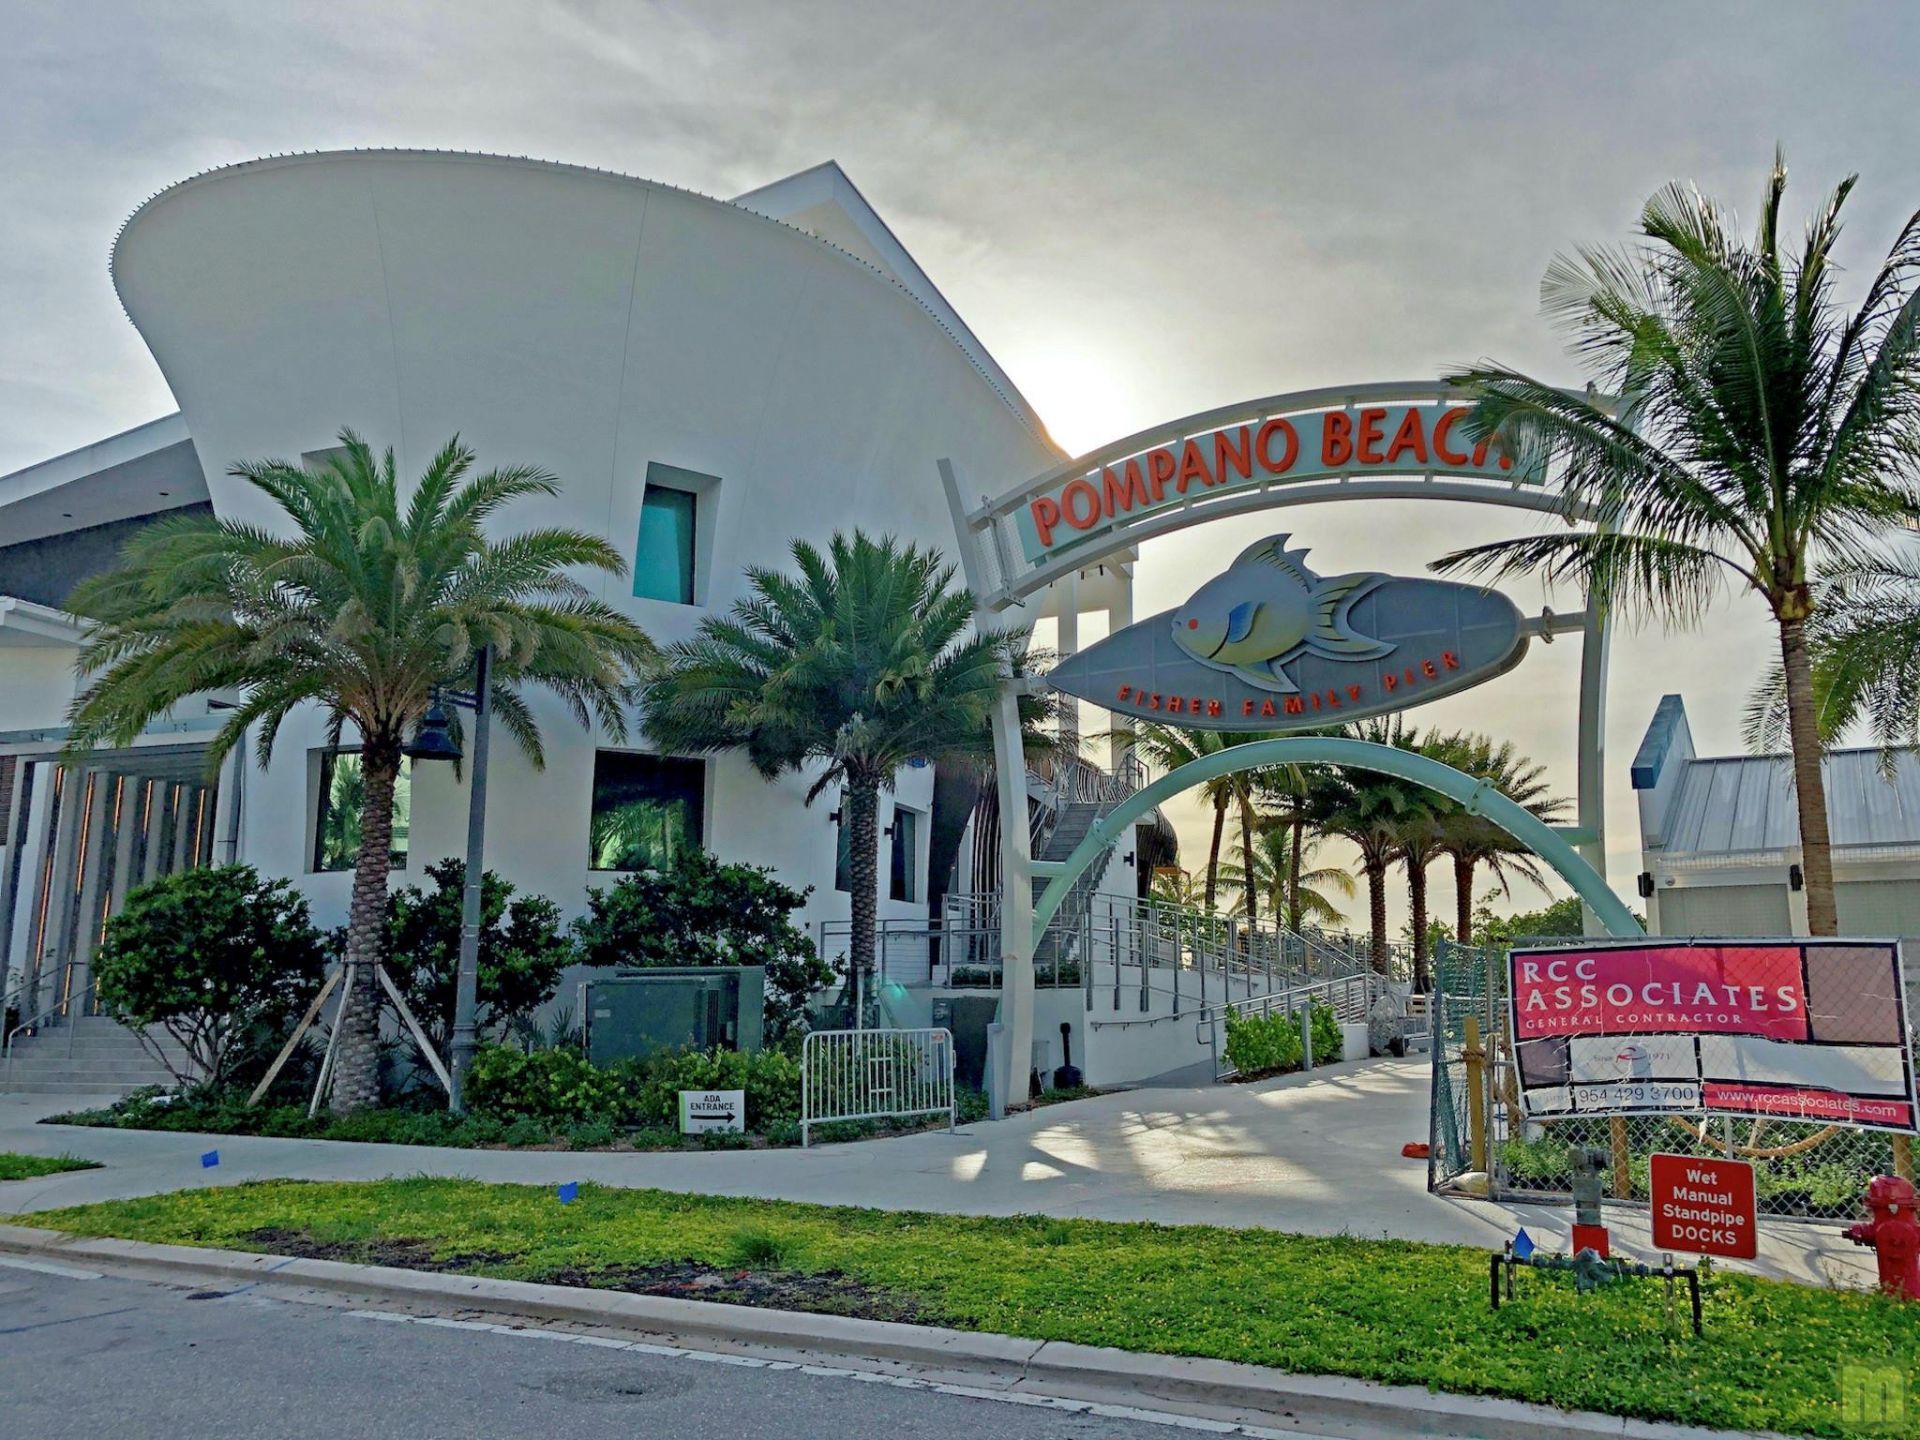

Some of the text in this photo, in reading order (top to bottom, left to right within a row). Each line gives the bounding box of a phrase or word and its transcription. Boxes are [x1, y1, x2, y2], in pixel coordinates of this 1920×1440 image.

[1030, 418, 1300, 547] POMPANO
[1116, 651, 1461, 718] FISHER FAMILY PIER
[1523, 959, 1598, 984] RCC
[1525, 982, 1798, 1012] ASSOCIATES
[1525, 1013, 1743, 1029] GENERAL CONTRACTOR
[704, 1094, 721, 1103] ADA
[1579, 1089, 1608, 1103] 954
[1614, 1088, 1645, 1101] 429
[1650, 1086, 1694, 1101] 3700
[1717, 1090, 1897, 1117] www.rccassociates.com
[690, 1102, 735, 1111] ENTRANCE
[1686, 1168, 1718, 1186] Wet
[1673, 1186, 1733, 1207] Manual
[1663, 1203, 1745, 1228] Standpipe
[1672, 1225, 1737, 1246] DOCKS
